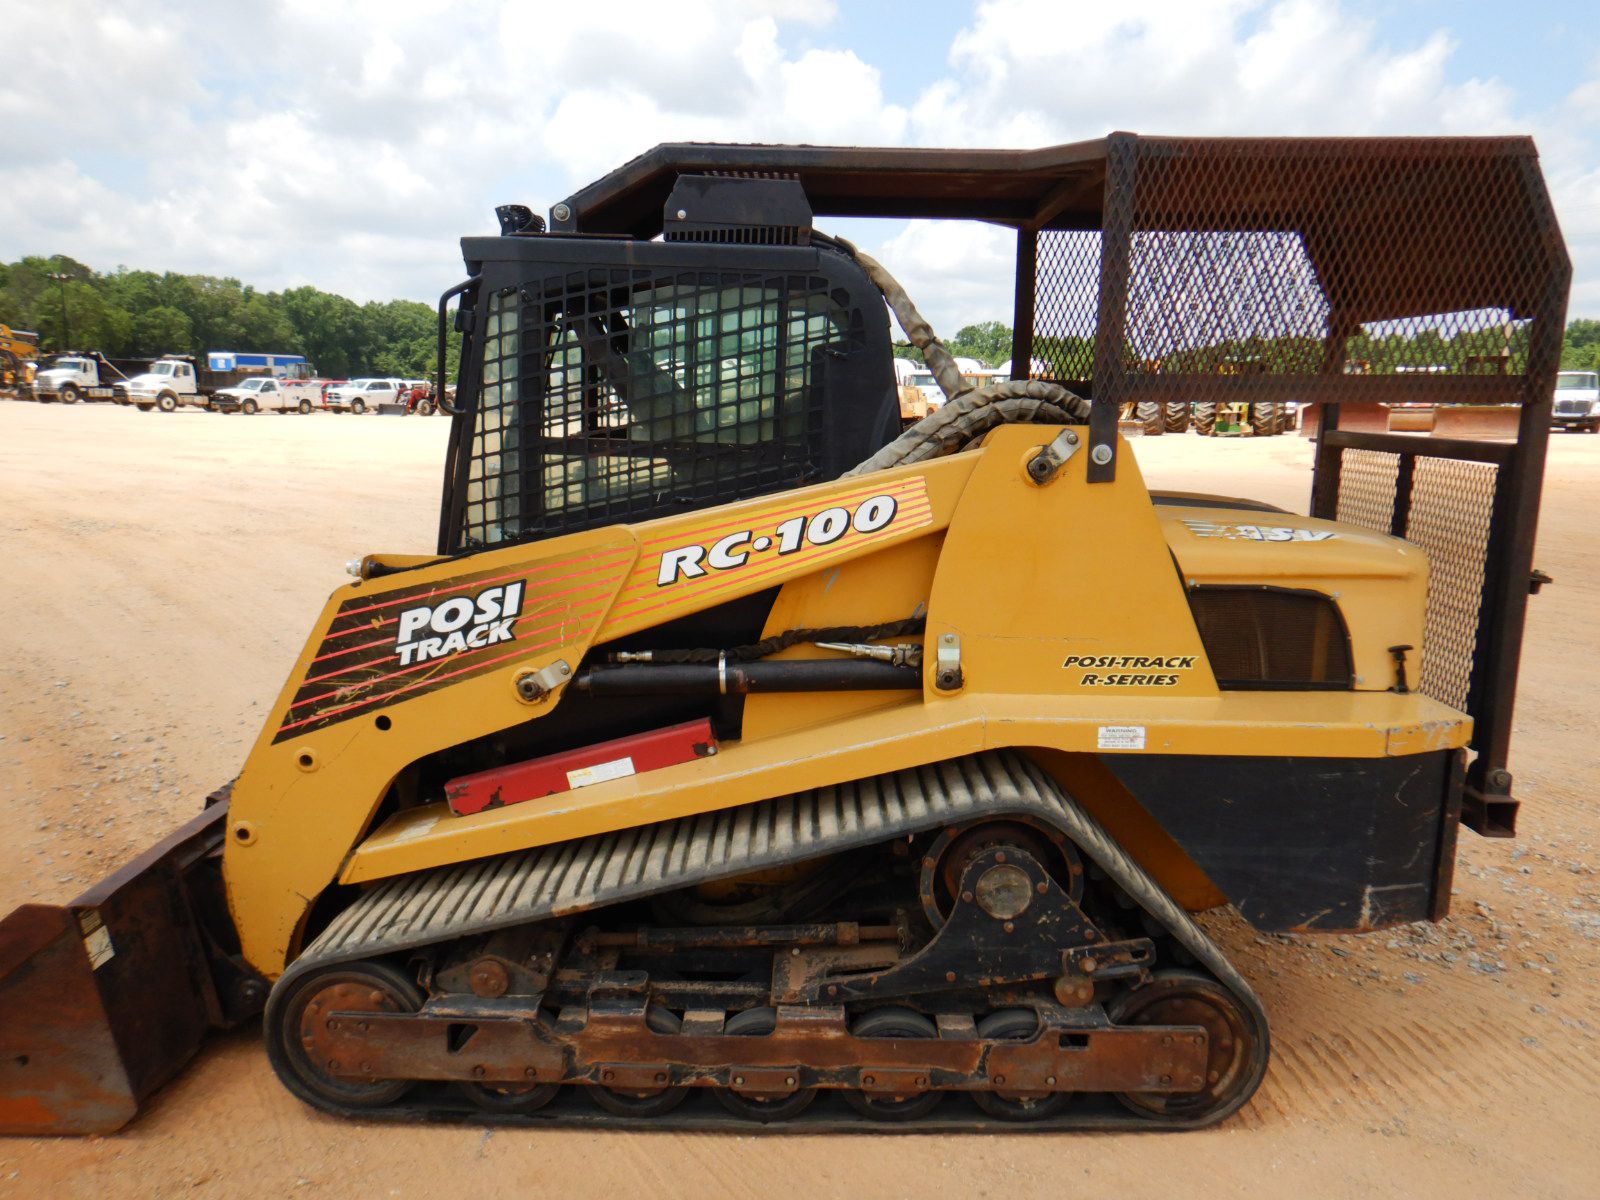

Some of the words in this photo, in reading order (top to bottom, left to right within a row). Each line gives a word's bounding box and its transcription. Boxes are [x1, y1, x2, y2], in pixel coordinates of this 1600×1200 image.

[396, 582, 523, 644] POSI
[395, 619, 517, 666] TRACK
[1063, 656, 1197, 668] POSI-TRACK
[1081, 674, 1180, 686] R-SERIES
